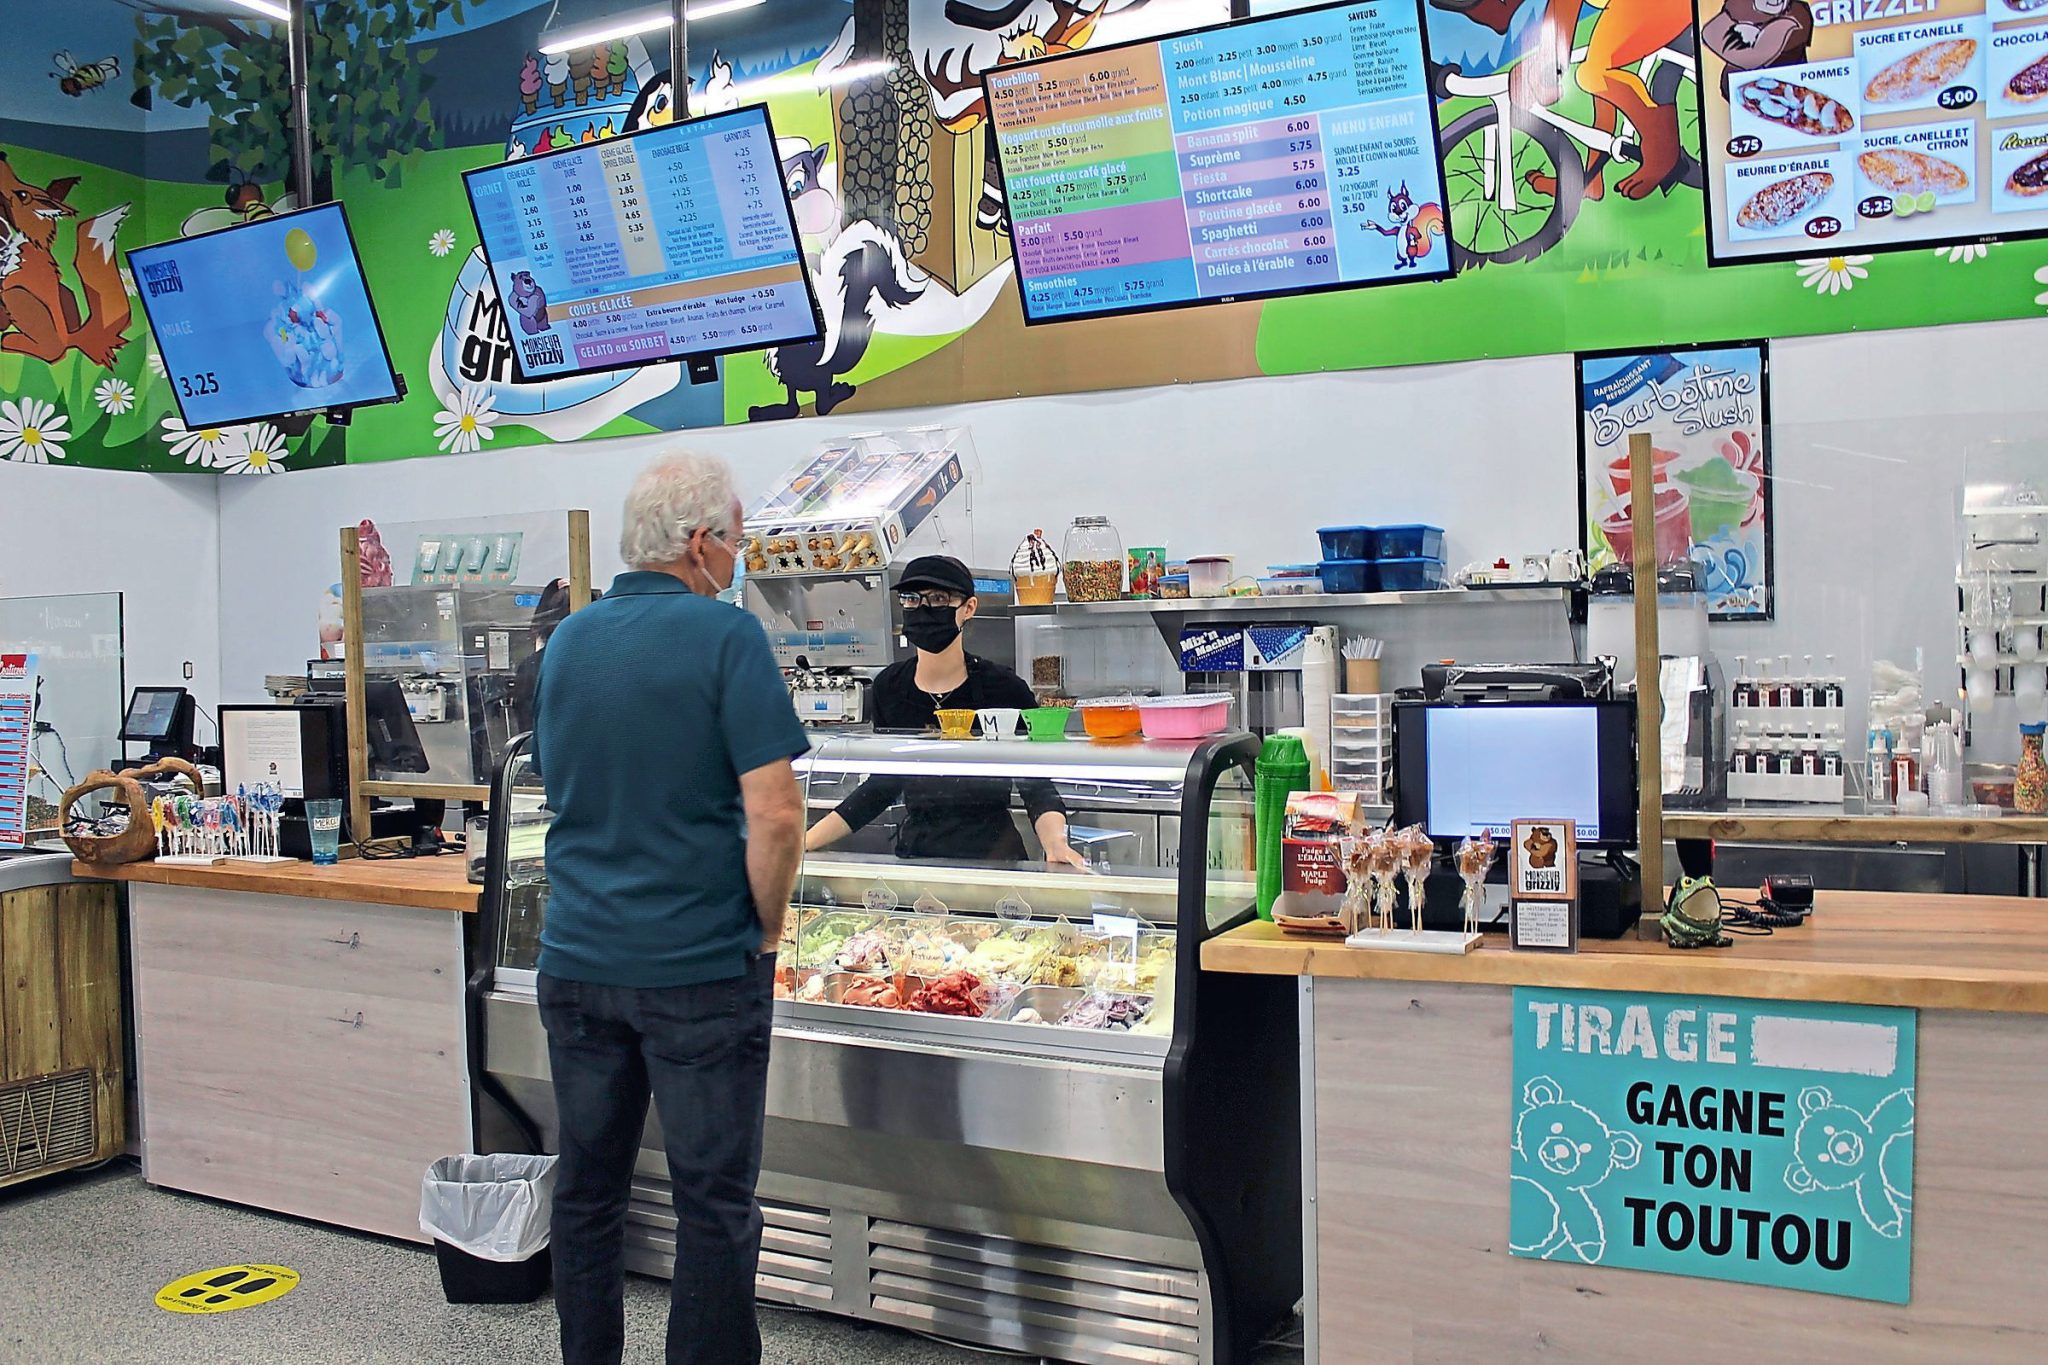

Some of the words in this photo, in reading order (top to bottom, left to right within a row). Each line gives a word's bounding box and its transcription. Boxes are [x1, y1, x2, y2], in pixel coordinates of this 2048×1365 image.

[1348, 10, 1377, 22] SAVEURS
[1860, 33, 1896, 46] SUCRE
[1898, 31, 1912, 42] ET
[1914, 24, 1964, 38] CANELLE
[1172, 38, 1204, 54] Slush
[1176, 60, 1194, 70] 2.00
[1218, 52, 1237, 62] 2.25
[1256, 44, 1276, 55] 3.00
[1302, 36, 1323, 48] 3.50
[991, 70, 1040, 89] Tourbillon
[1178, 72, 1208, 89] Mont
[1210, 67, 1242, 84] Blanc
[1249, 56, 1315, 75] Mousseline
[1800, 66, 1850, 80] POMMES
[994, 88, 1014, 100] 4.50
[1038, 80, 1058, 92] 5.25
[1089, 70, 1110, 82] 6.00
[1110, 67, 1130, 80] grand
[1180, 94, 1199, 104] 2.50
[1224, 86, 1242, 96] 3.25
[1262, 79, 1282, 90] 4.00
[1308, 72, 1328, 82] 4.75
[1942, 90, 1974, 104] 5,00
[1183, 106, 1220, 123] Potion
[1223, 99, 1274, 116] magique
[1284, 94, 1306, 106] 4.50
[1000, 126, 1039, 145] Yogourt
[1051, 122, 1073, 136] tofu
[1086, 116, 1114, 130] molle
[1115, 114, 1135, 124] aux
[1135, 107, 1164, 122] fruits
[1332, 117, 1366, 136] MENU
[1370, 112, 1415, 129] ENFANT
[1187, 132, 1230, 148] Banana
[1232, 126, 1260, 142] split
[1287, 120, 1310, 132] 6.00
[1904, 130, 1950, 144] CANELLE
[1954, 128, 1968, 138] ET
[1004, 144, 1024, 156] 4.25
[1048, 137, 1068, 148] 5.50
[1360, 142, 1382, 152] ENFANT
[1394, 137, 1416, 147] SOURIS
[1730, 139, 1760, 152] 5,75
[1926, 138, 1968, 151] CITRON
[734, 147, 750, 158] +.25
[1190, 150, 1241, 168] Suprême
[1290, 140, 1312, 152] 5.75
[1365, 150, 1388, 161] CLOWN
[1398, 147, 1419, 157] NUAGE
[668, 162, 683, 172] +.50
[738, 160, 754, 170] +.75
[1338, 166, 1360, 177] 3.25
[1737, 165, 1776, 178] BEURRE
[1778, 158, 1830, 173] D'ÉRABLE
[616, 173, 631, 183] 1.25
[669, 174, 688, 184] +1.05
[741, 173, 756, 184] +.75
[1010, 177, 1028, 190] Lait
[1029, 170, 1066, 186] fouetté
[1080, 164, 1100, 178] café
[1100, 161, 1127, 178] glacé
[1193, 171, 1228, 186] Fiesta
[1293, 159, 1315, 171] 5.75
[474, 182, 502, 198] CORNET
[566, 184, 582, 193] 1.00
[618, 185, 634, 195] 2.85
[744, 186, 760, 196] +.75
[1012, 190, 1032, 201] 4.25
[1056, 183, 1076, 194] 4.75
[1106, 174, 1127, 186] 5.75
[1128, 172, 1147, 184] grand
[1196, 185, 1253, 204] Shortcake
[1296, 178, 1318, 190] 6.00
[1350, 180, 1378, 190] YOGOURT
[521, 194, 536, 203] 1.00
[672, 187, 691, 198] +1.25
[1362, 190, 1378, 199] TOFU
[570, 196, 585, 206] 2.60
[622, 198, 638, 208] 3.90
[675, 200, 694, 210] +1.75
[748, 200, 763, 210] +.75
[1861, 200, 1892, 214] 5,25
[524, 206, 538, 215] 2.60
[573, 208, 588, 218] 3.15
[625, 211, 641, 220] 4.65
[1199, 206, 1243, 222] Poutine
[1245, 200, 1282, 219] glacée
[1298, 198, 1320, 209] 6.00
[1342, 203, 1365, 214] 3.50
[528, 218, 542, 228] 3.15
[576, 221, 592, 230] 3.65
[678, 213, 698, 224] +2.25
[628, 223, 644, 232] 5.35
[1018, 222, 1052, 236] Parfait
[1202, 221, 1258, 242] Spaghetti
[1300, 216, 1323, 228] 6.00
[1808, 219, 1838, 233] 6,25
[530, 230, 545, 240] 3.65
[580, 233, 595, 242] 4.85
[1021, 236, 1040, 247] 5.00
[1064, 230, 1084, 241] 5.50
[534, 242, 548, 252] 4.85
[1204, 243, 1240, 260] Carrés
[1241, 238, 1290, 254] chocolat
[1304, 235, 1326, 247] 6.00
[1207, 262, 1242, 278] Délice
[1252, 256, 1295, 270] l'érable
[1306, 254, 1328, 265] 6.00
[148, 274, 183, 298] grizzly
[1028, 276, 1078, 292] Smoothies
[1031, 292, 1050, 302] 4.25
[1074, 286, 1094, 296] 4.75
[1124, 280, 1145, 291] 5.75
[758, 288, 774, 298] 0.50
[568, 303, 598, 318] COUPE
[600, 296, 633, 312] GLACÉE
[572, 319, 588, 328] 4.00
[606, 314, 622, 323] 5.00
[670, 336, 686, 345] 4.50
[702, 330, 718, 340] 5.50
[741, 325, 758, 334] 6.50
[520, 334, 560, 354] MONSIEUR
[580, 342, 613, 358] GELATO
[630, 334, 664, 350] SORBET
[526, 348, 564, 368] grizzly
[180, 372, 220, 398] 3.25
[1606, 376, 1644, 401] REFRESHING
[1590, 364, 1754, 446] Barbotine
[1674, 396, 1754, 436] Slush
[1195, 632, 1242, 656] Machine
[1490, 827, 1510, 836] $0.00
[1576, 828, 1597, 836] $0.00
[1525, 870, 1560, 880] MONSIEUR
[1526, 880, 1560, 891] grizzly
[1528, 1001, 1738, 1064] TIRAGE
[1626, 1080, 1786, 1136] GAGNE
[1655, 1141, 1752, 1193] TON
[1624, 1196, 1852, 1272] TOUTOU
